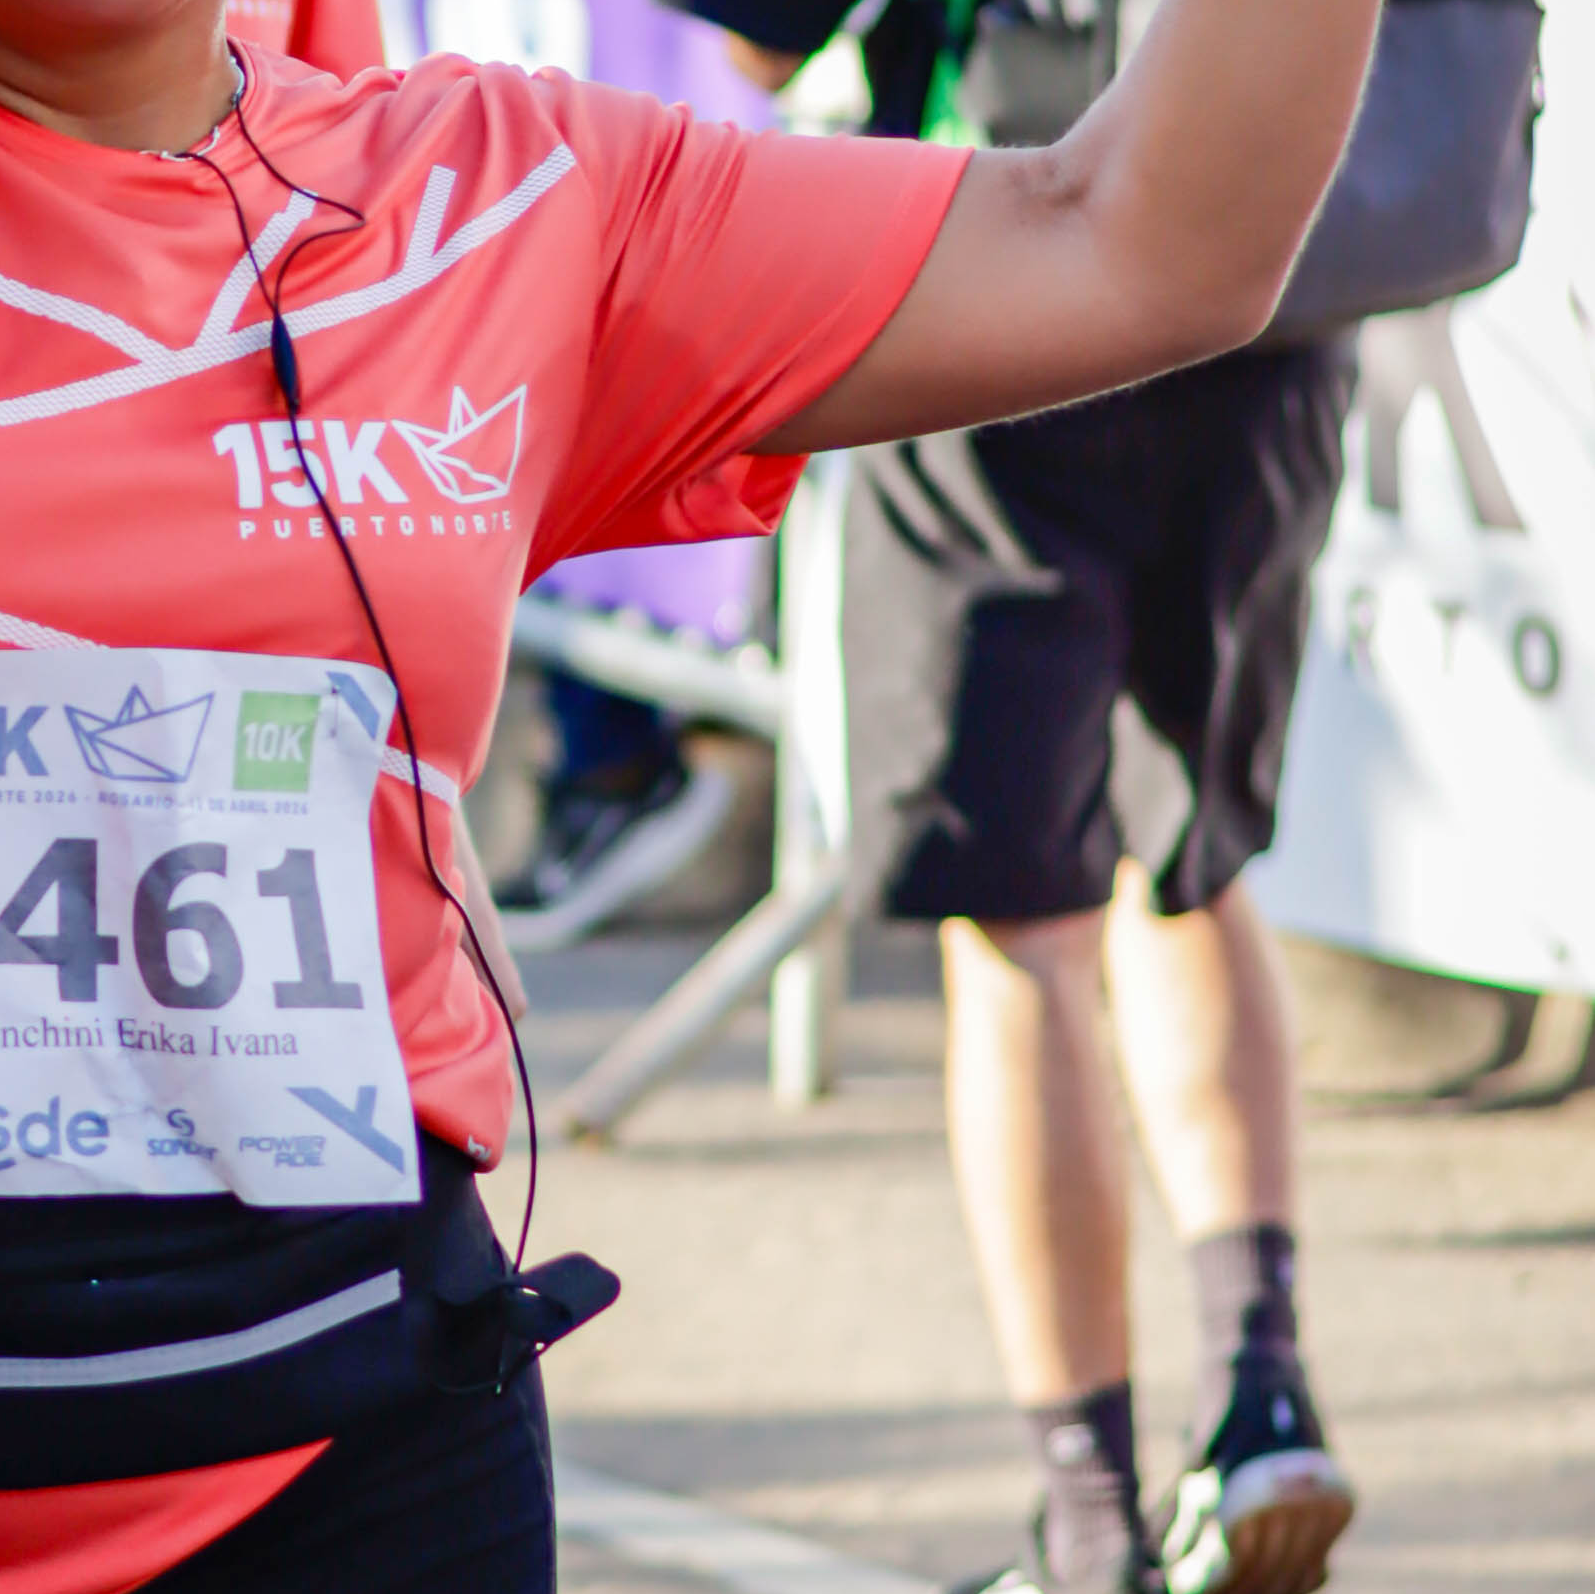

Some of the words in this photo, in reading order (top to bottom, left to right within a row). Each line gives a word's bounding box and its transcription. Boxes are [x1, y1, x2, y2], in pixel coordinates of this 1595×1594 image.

[212, 419, 410, 510] 15K
[239, 514, 415, 540] PUERTO
[430, 509, 513, 536] NORTE
[243, 722, 307, 763] 10K
[116, 1017, 197, 1055] Erika
[209, 1024, 299, 1055] Ivana
